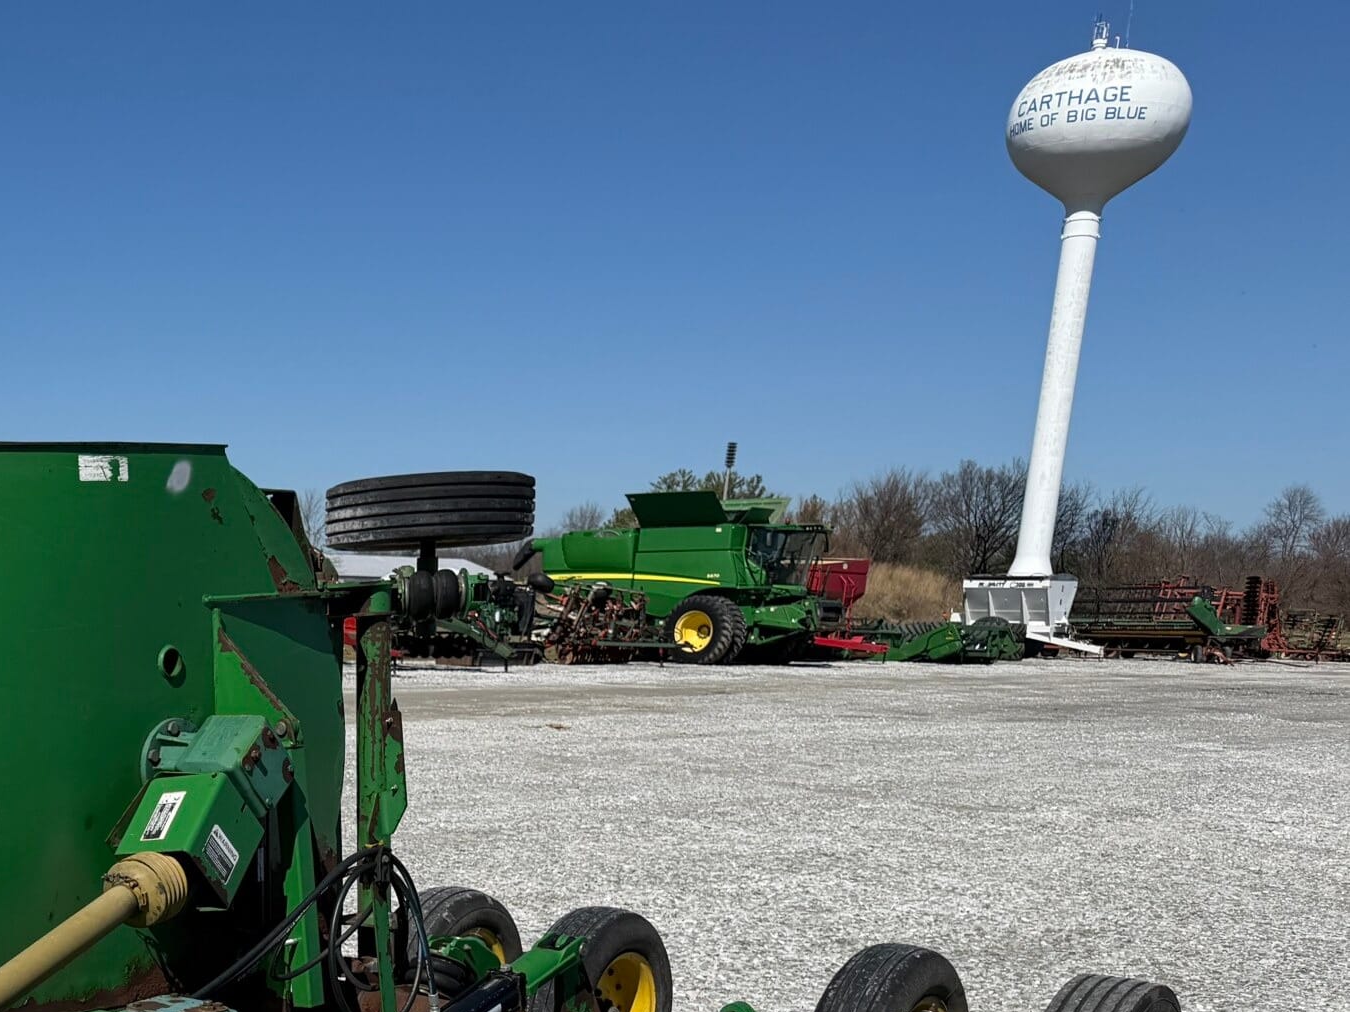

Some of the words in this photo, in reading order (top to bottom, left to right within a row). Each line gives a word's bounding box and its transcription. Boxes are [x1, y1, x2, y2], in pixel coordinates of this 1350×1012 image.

[1018, 86, 1132, 117] CARTHAGE
[1009, 118, 1034, 136] HOME
[1040, 113, 1058, 127] OF
[1066, 108, 1097, 123] BIG
[1104, 107, 1148, 120] BLUE
